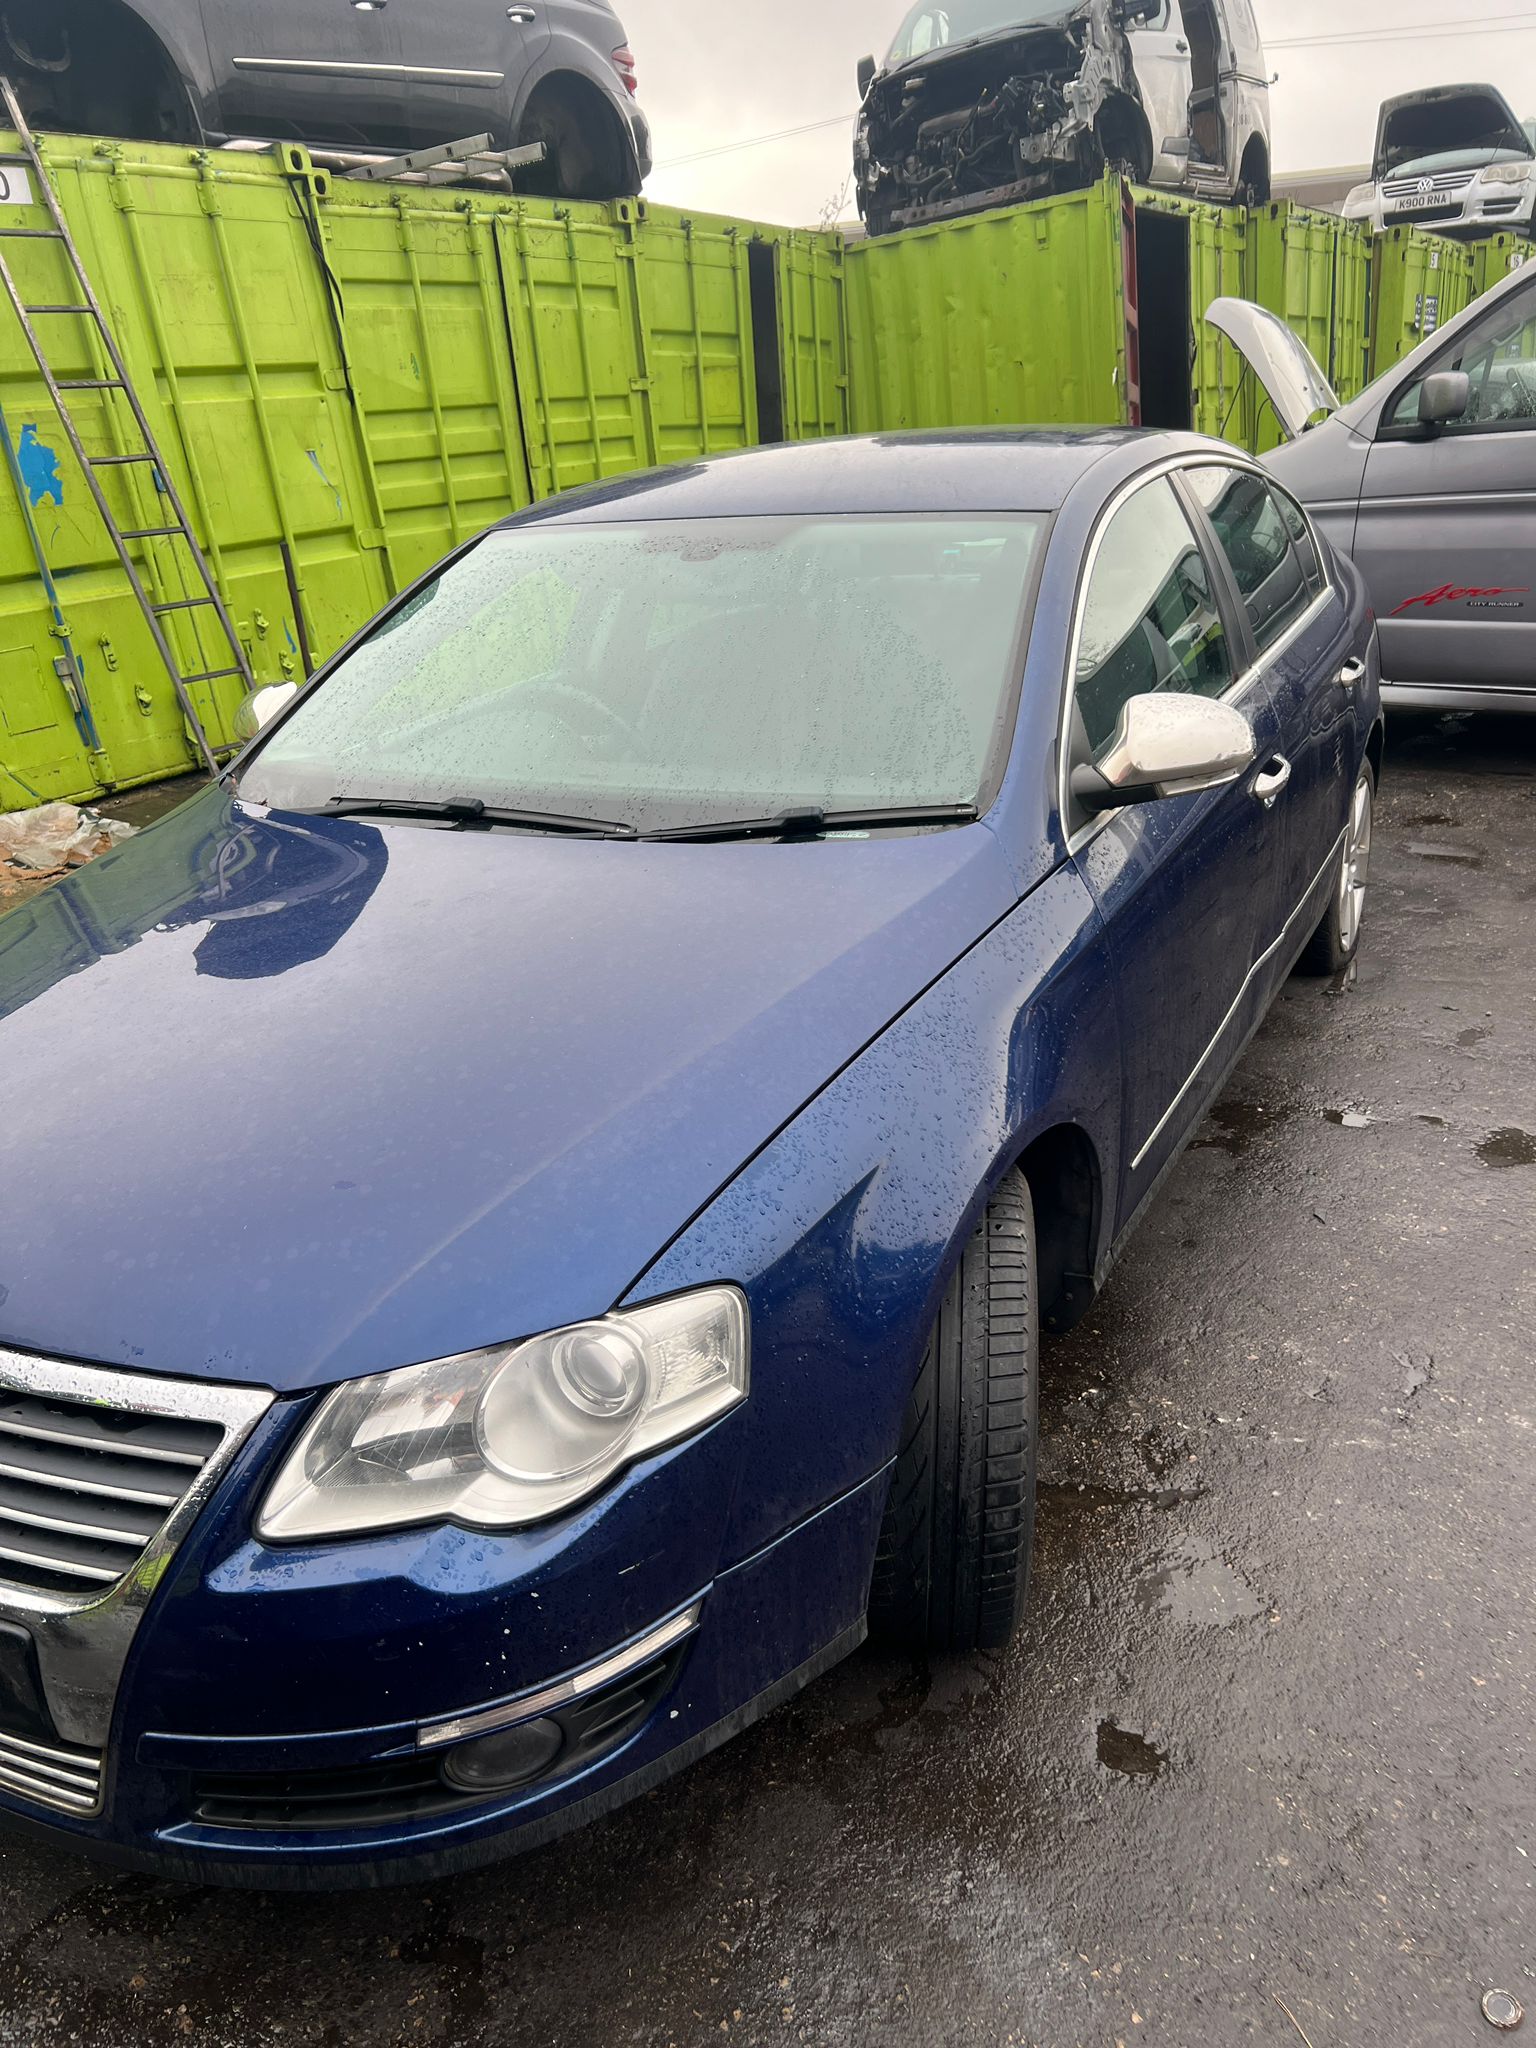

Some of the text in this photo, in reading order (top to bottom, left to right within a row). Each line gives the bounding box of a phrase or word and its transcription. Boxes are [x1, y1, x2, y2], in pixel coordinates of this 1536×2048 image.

[1400, 193, 1447, 209] K900 RNA
[1388, 582, 1530, 616] Aero
